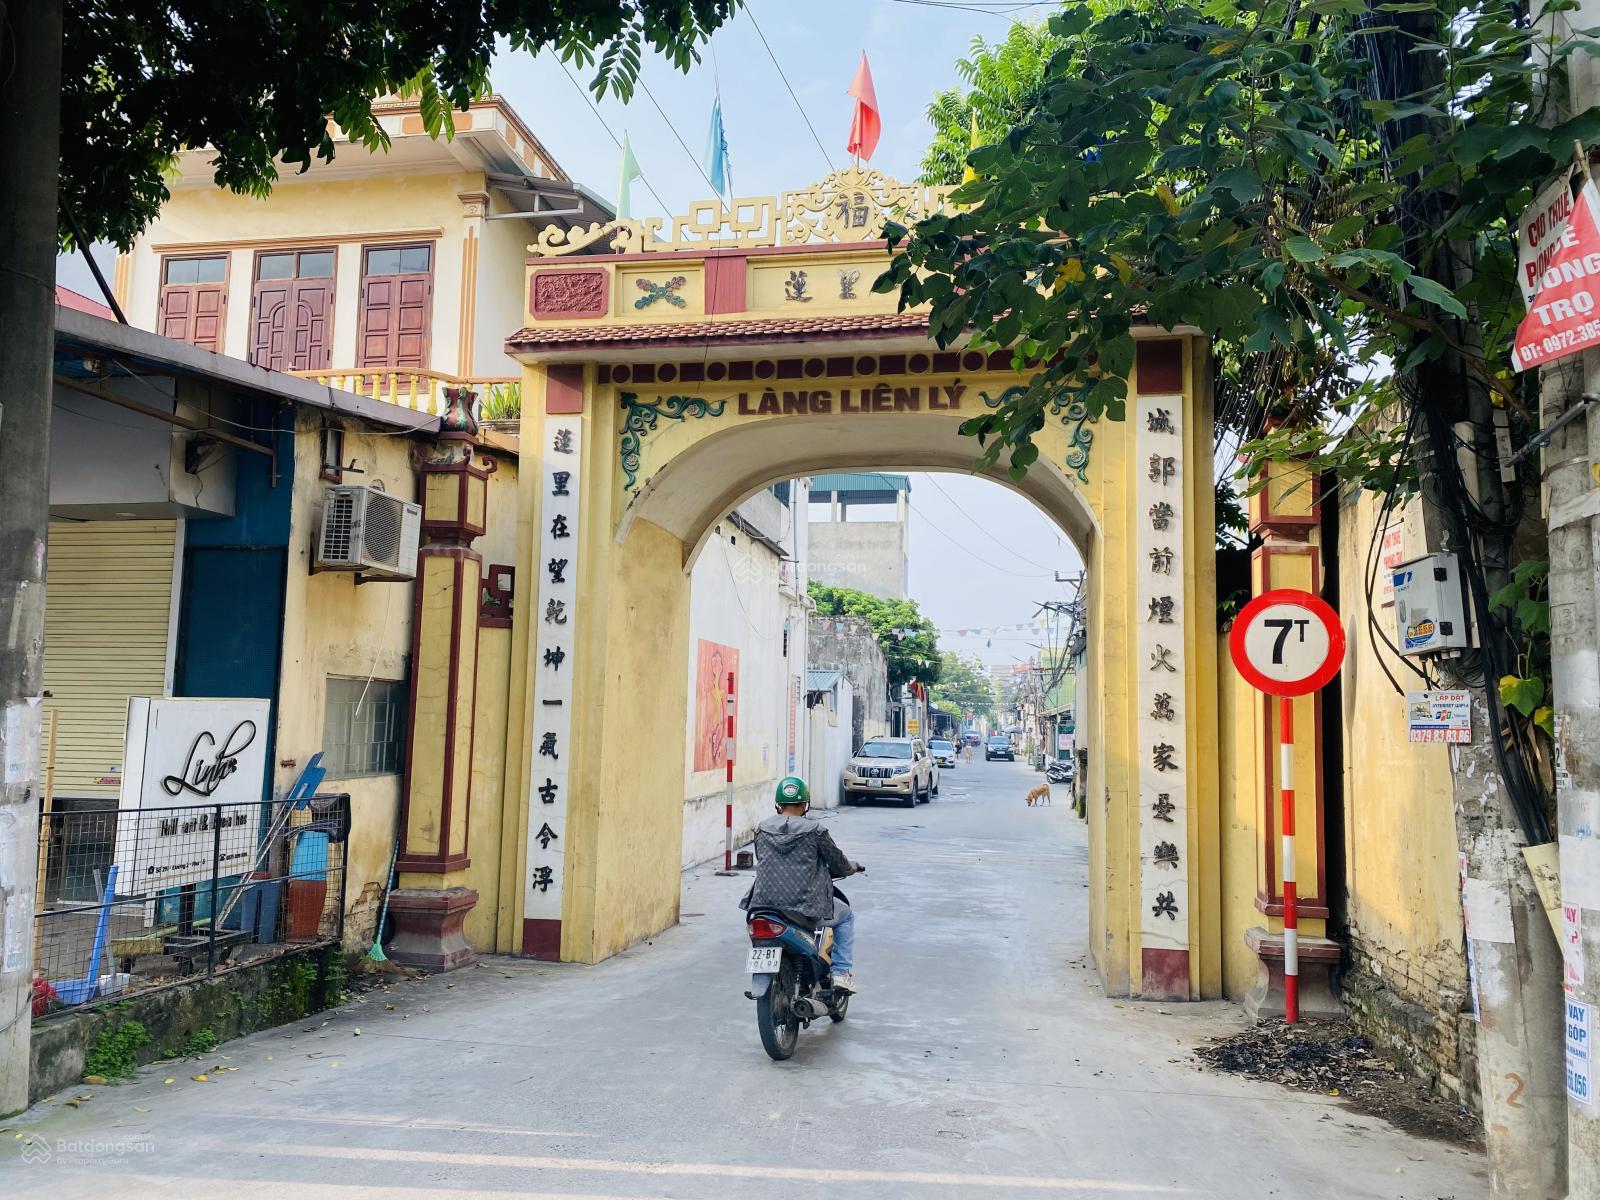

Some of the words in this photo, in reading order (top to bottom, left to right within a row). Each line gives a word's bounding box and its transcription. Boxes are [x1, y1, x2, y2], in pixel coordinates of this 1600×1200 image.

[835, 191, 869, 229] 福
[1533, 291, 1595, 327] TRỌ
[738, 387, 832, 416] LÀNG
[841, 383, 920, 413] LIÊN
[929, 378, 967, 411] LÝ
[752, 949, 776, 960] 22-B1
[1568, 1003, 1585, 1023] VAY
[1568, 1024, 1587, 1043] GÓP
